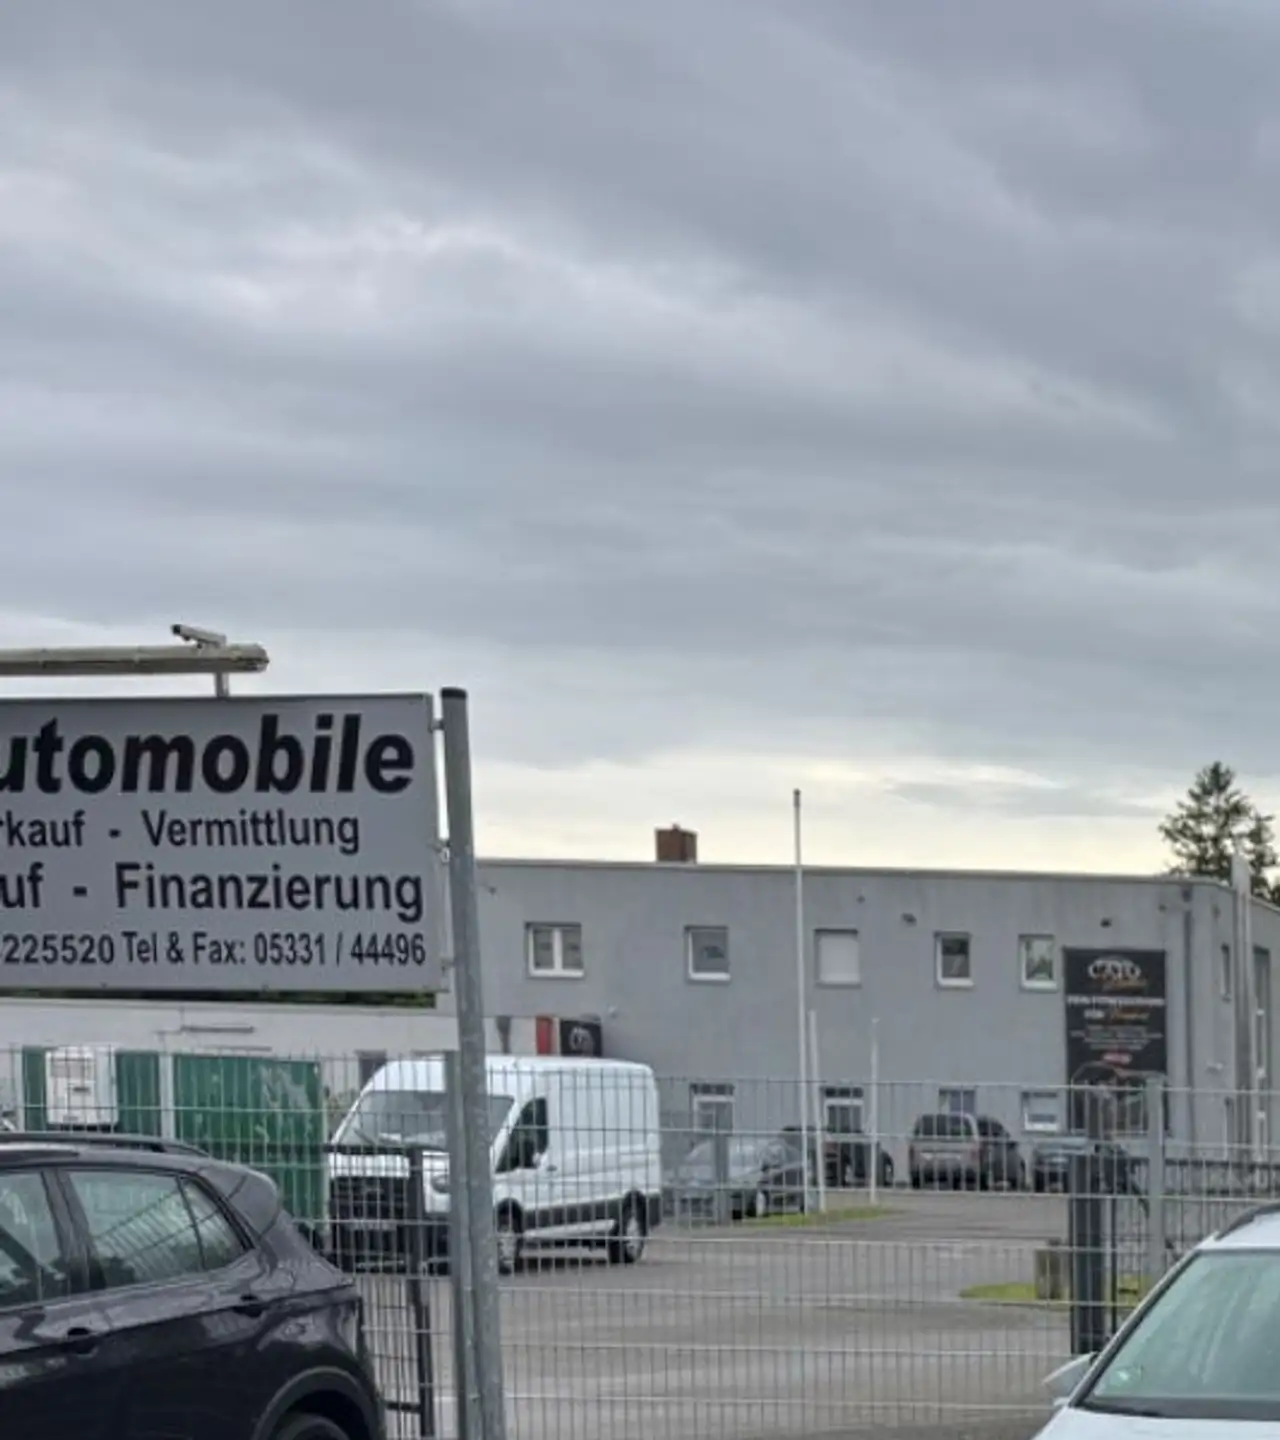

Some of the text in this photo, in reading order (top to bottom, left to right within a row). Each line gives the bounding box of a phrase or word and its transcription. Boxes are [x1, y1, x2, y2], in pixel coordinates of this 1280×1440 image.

[141, 807, 360, 856] Vermittlung
[115, 861, 423, 924] Finanzierung
[121, 931, 157, 963] Tel
[167, 931, 184, 964] &
[193, 931, 246, 965] Fax:
[253, 932, 325, 966] 05331
[350, 932, 426, 966] 44496
